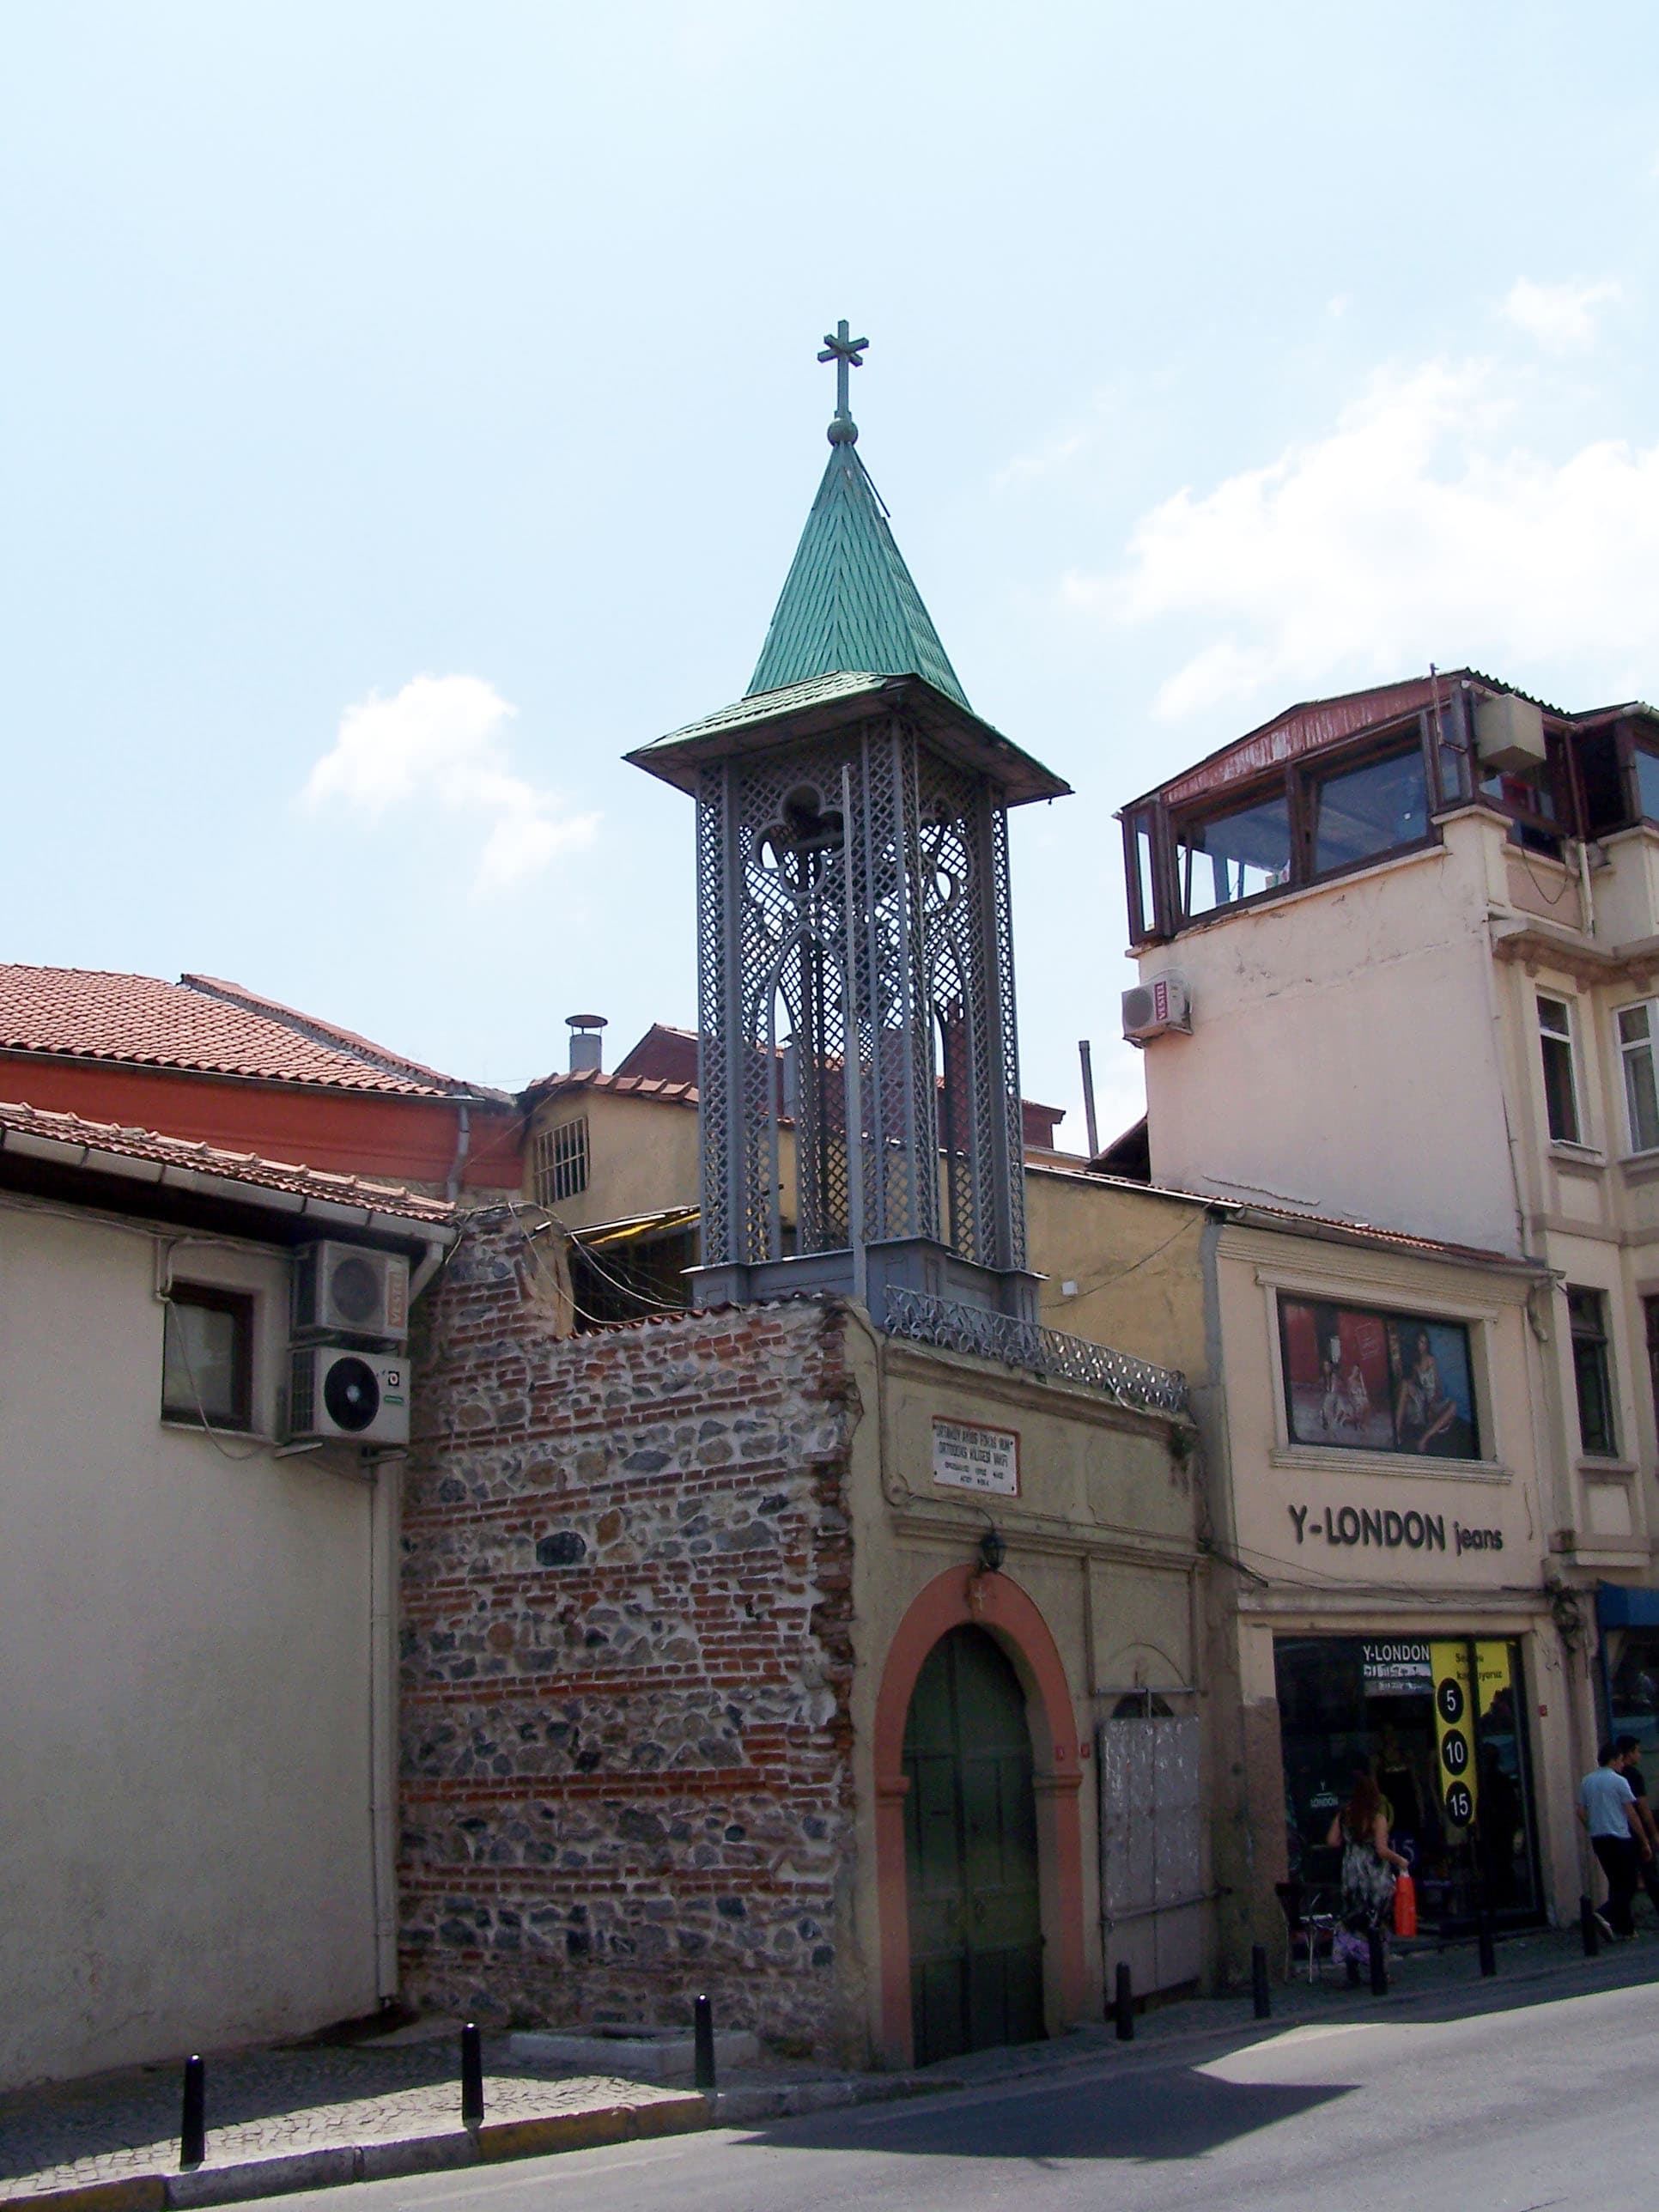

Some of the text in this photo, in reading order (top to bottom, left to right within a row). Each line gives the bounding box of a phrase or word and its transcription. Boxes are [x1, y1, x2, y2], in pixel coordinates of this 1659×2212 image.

[1289, 1504, 1503, 1556] Y-LONDON jeans
[1363, 1644, 1430, 1662] Y-LONDON
[1446, 1690, 1456, 1711] 5
[1446, 1741, 1464, 1764] 10
[1450, 1793, 1469, 1817] 15
